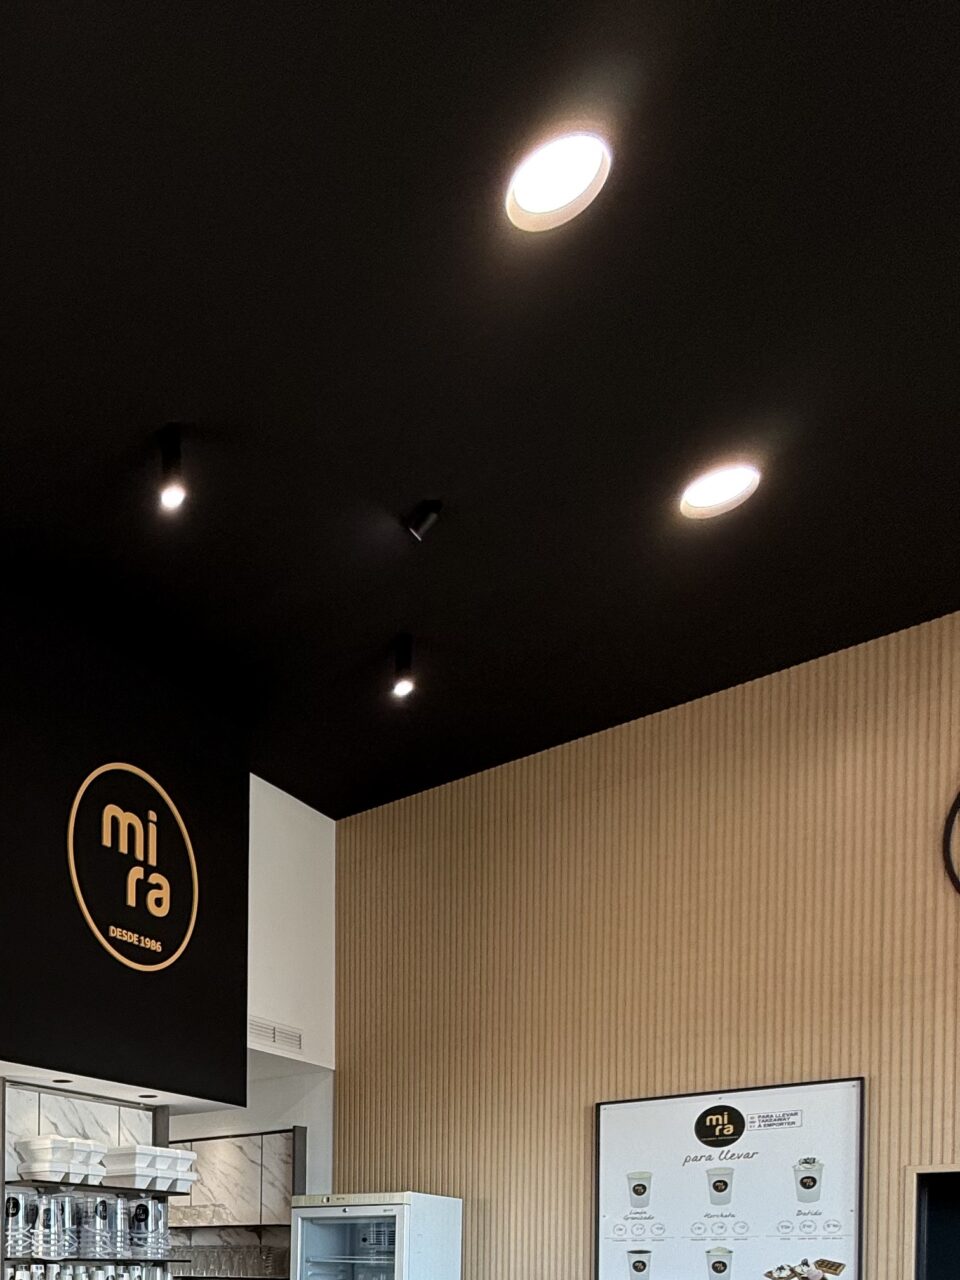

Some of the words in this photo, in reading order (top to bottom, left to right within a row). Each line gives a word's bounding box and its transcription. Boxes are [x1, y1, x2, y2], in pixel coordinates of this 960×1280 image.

[101, 803, 158, 867] mi
[126, 866, 171, 918] ra
[109, 925, 139, 944] DESDE
[139, 935, 162, 952] 1986
[706, 1112, 729, 1126] mi
[715, 1124, 734, 1136] ra
[682, 1153, 714, 1166] para
[718, 1150, 759, 1161] llevar
